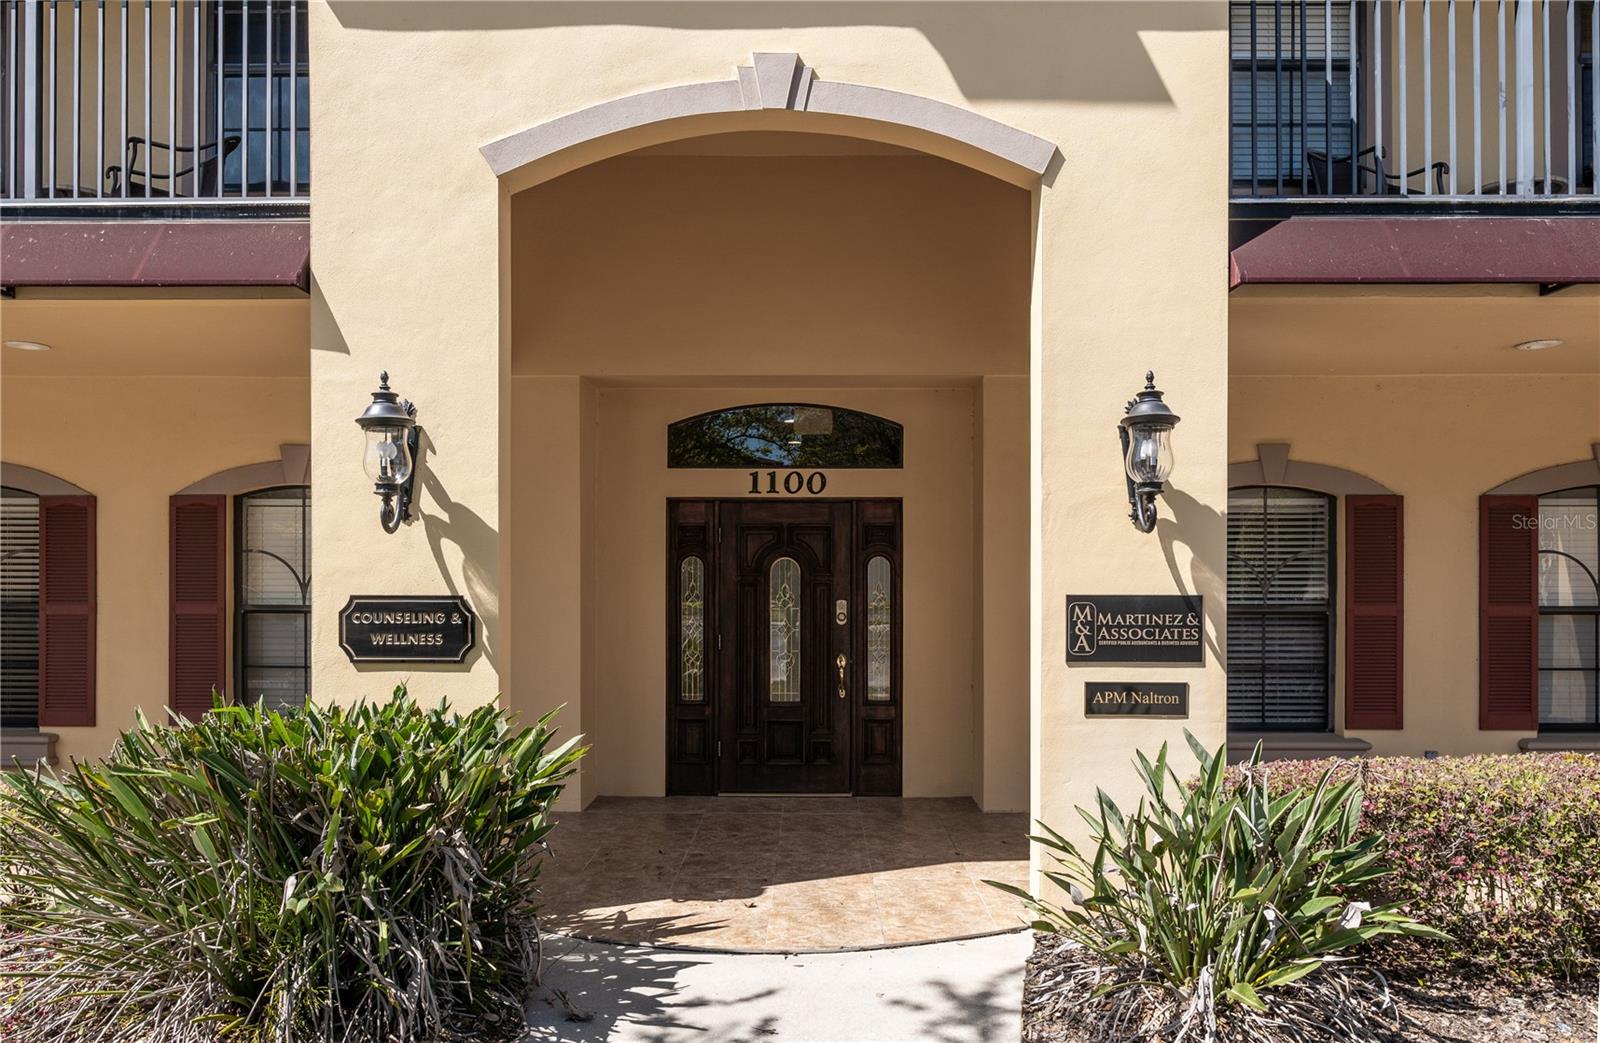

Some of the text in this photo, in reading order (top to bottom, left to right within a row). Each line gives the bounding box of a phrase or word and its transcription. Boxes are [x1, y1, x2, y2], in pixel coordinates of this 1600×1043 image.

[748, 471, 827, 494] 1100
[351, 612, 463, 625] COUNSELING &
[1097, 612, 1200, 626] MARTINEZ &
[370, 633, 444, 645] WELLNESS
[1097, 627, 1199, 640] ASSOCIATES
[1092, 691, 1179, 704] APM Naltron
